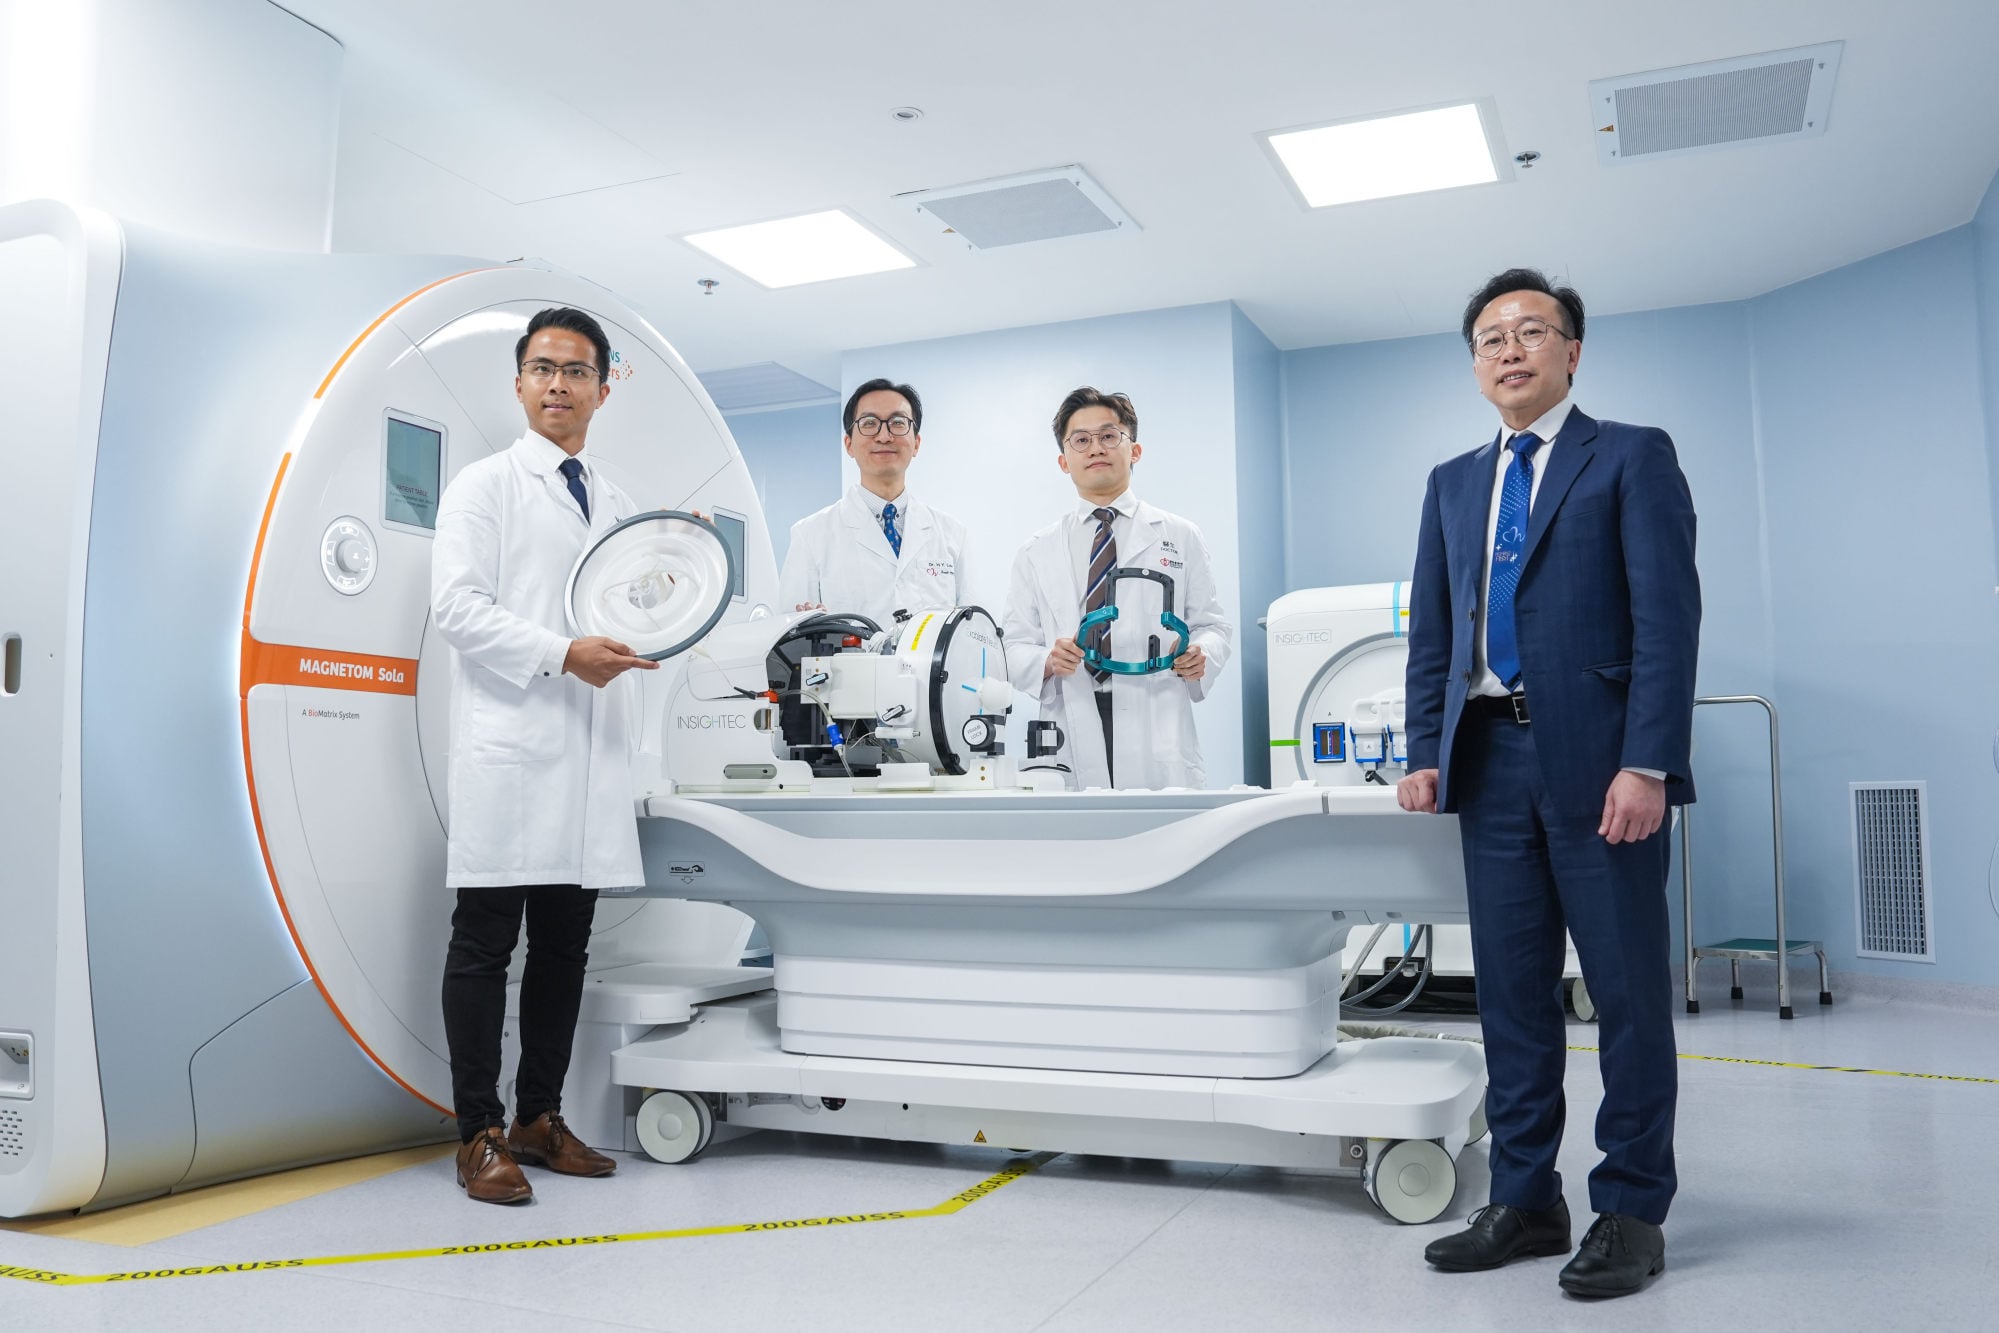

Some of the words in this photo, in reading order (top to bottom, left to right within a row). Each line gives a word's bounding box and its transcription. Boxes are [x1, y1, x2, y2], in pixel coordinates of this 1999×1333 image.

[299, 658, 374, 680] MAGNETOM
[378, 667, 404, 683] Sola
[302, 708, 307, 717] A
[308, 708, 338, 719] BioMatrix
[338, 710, 360, 721] System
[677, 714, 746, 729] INSIGHTEC
[952, 1168, 1028, 1202] 200GAUSS
[742, 1211, 905, 1232] 200GAUSS
[441, 1235, 619, 1255] 200GAUSS
[0, 1264, 69, 1281] AUSS
[105, 1258, 304, 1282] 200GAUSS
